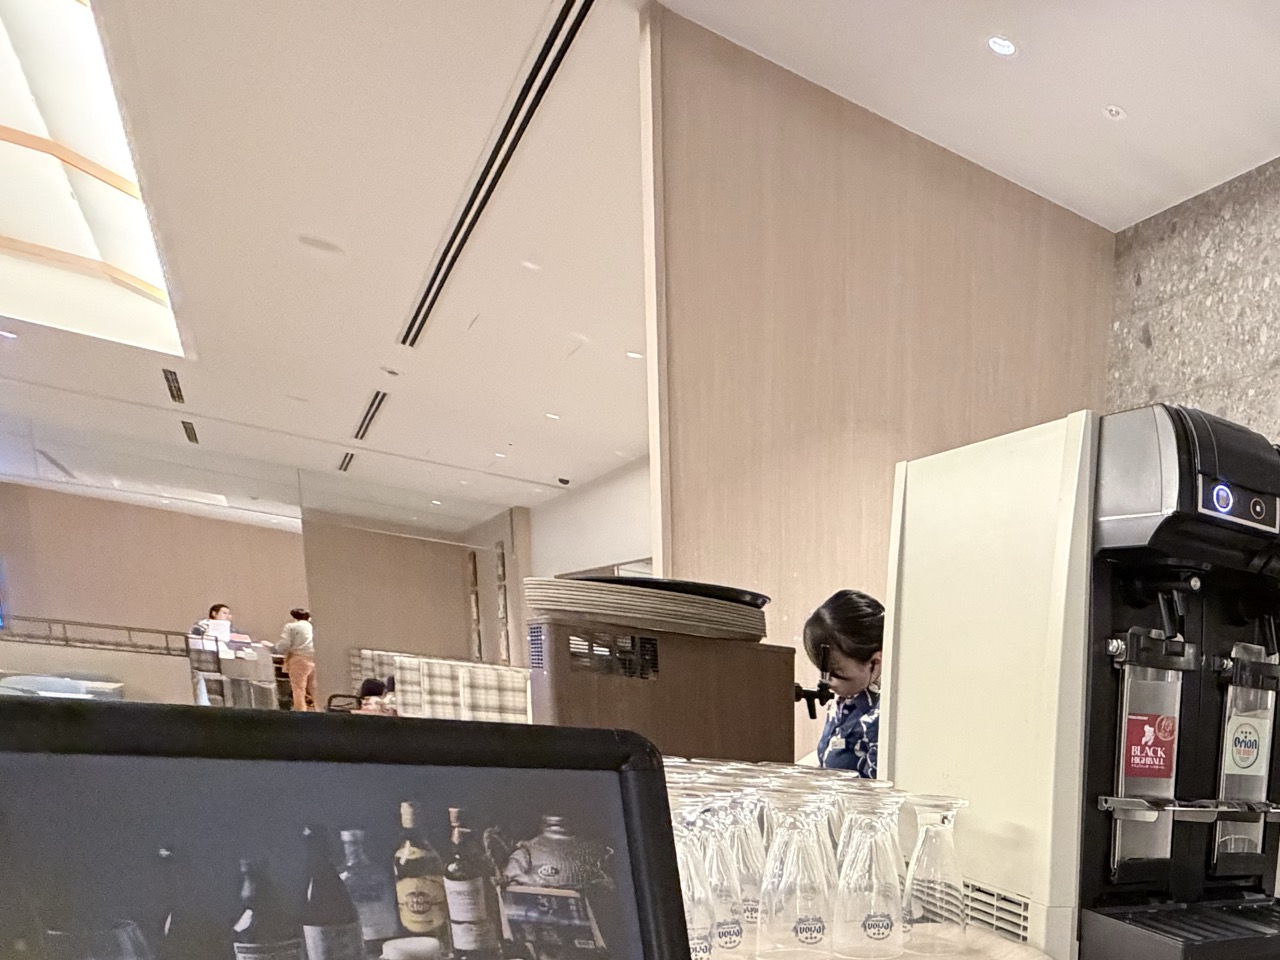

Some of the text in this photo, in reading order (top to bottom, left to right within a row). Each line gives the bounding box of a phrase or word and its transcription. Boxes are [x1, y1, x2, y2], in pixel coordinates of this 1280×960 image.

[1234, 737, 1258, 750] Orion
[1131, 745, 1166, 758] BLACK
[798, 925, 823, 935] Orion
[866, 920, 890, 931] Orion
